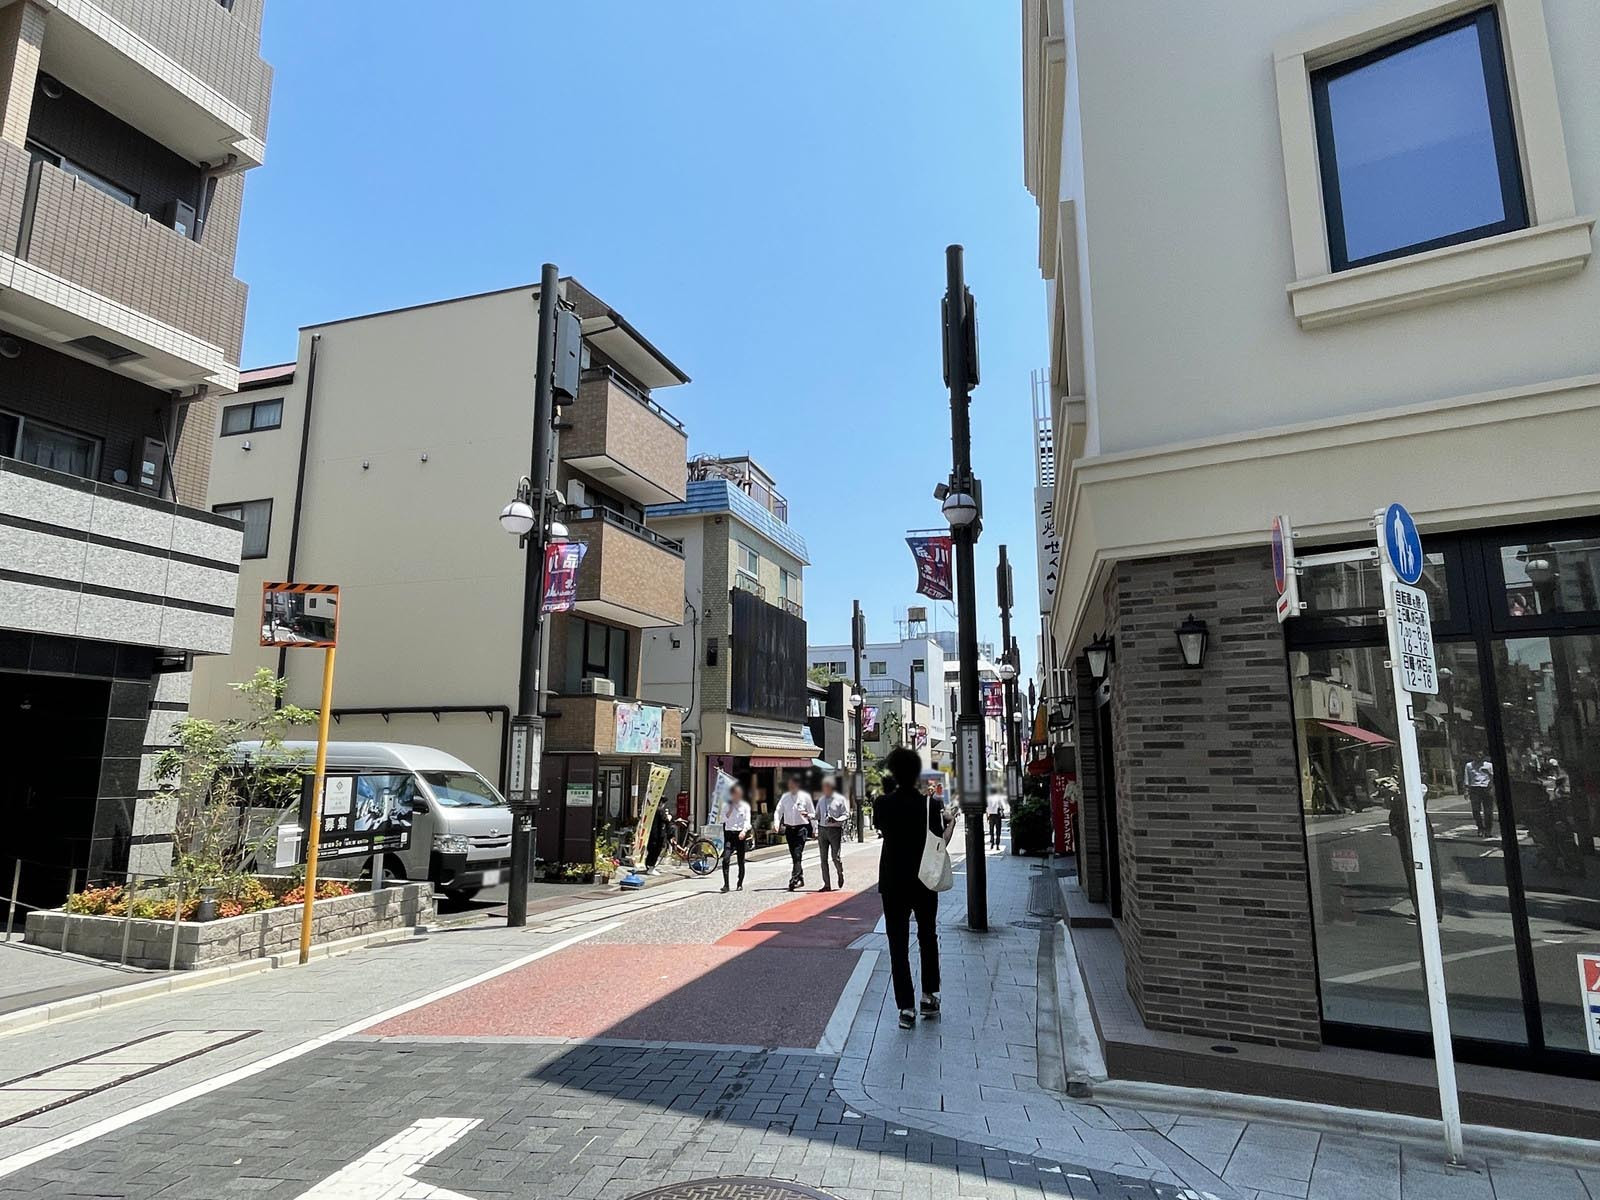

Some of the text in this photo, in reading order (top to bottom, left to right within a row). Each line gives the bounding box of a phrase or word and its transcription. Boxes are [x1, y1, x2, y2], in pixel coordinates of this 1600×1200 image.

[1404, 638, 1428, 656] 16-18
[1407, 671, 1431, 688] 12-18
[621, 719, 658, 738] クリーニング
